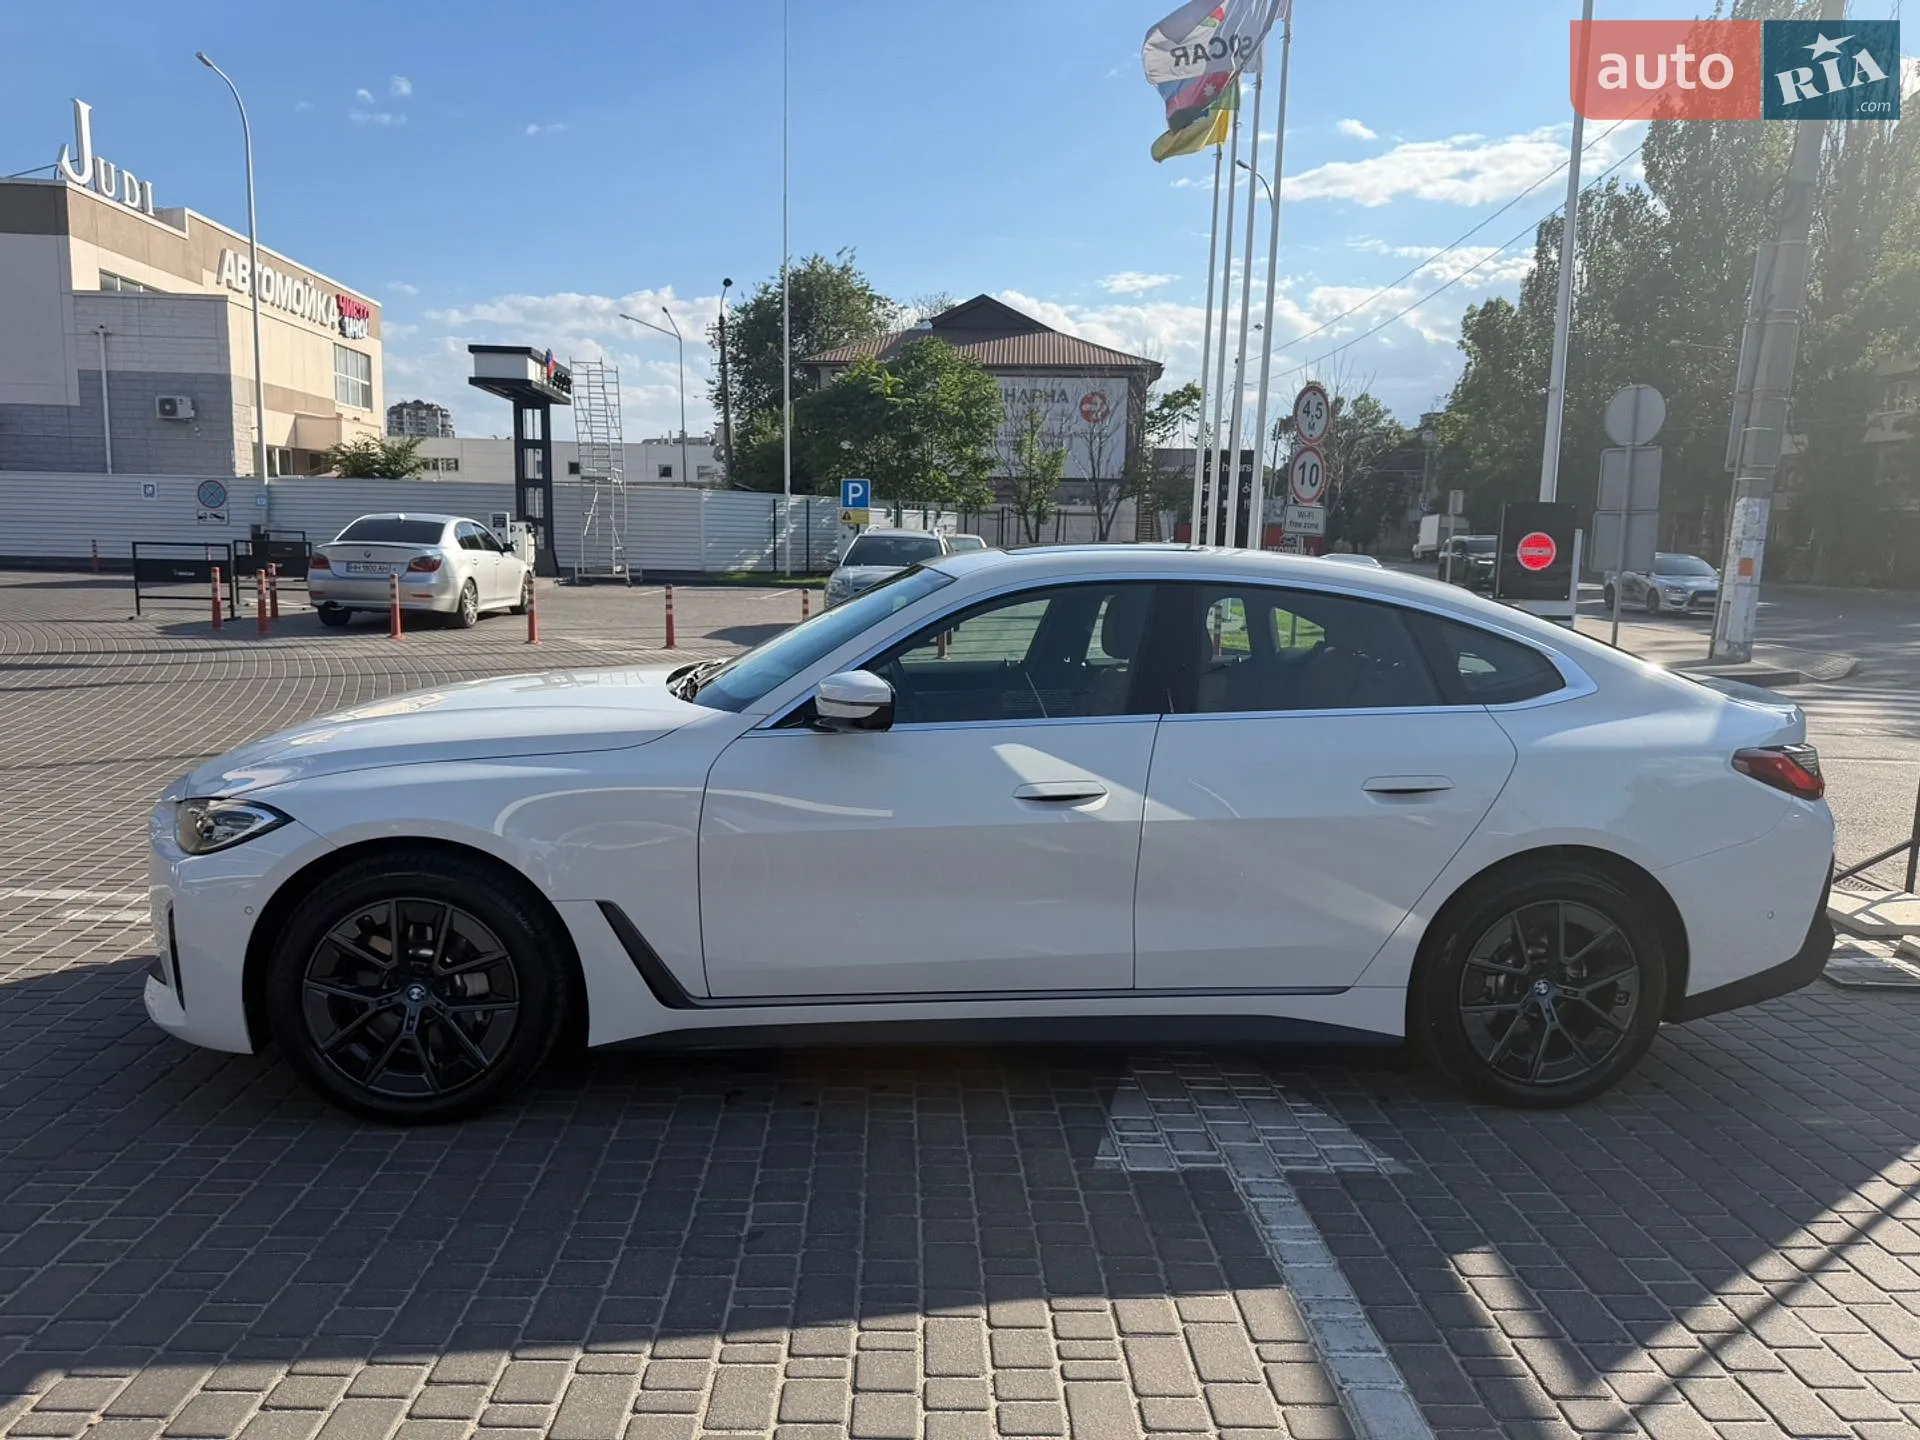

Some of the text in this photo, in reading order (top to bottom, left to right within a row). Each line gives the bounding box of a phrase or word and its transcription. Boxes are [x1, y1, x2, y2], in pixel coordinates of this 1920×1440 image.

[58, 98, 155, 216] JUDI
[1303, 400, 1323, 421] 4,5
[1222, 461, 1252, 472] hrs
[1299, 461, 1319, 487] 10
[848, 482, 863, 505] P
